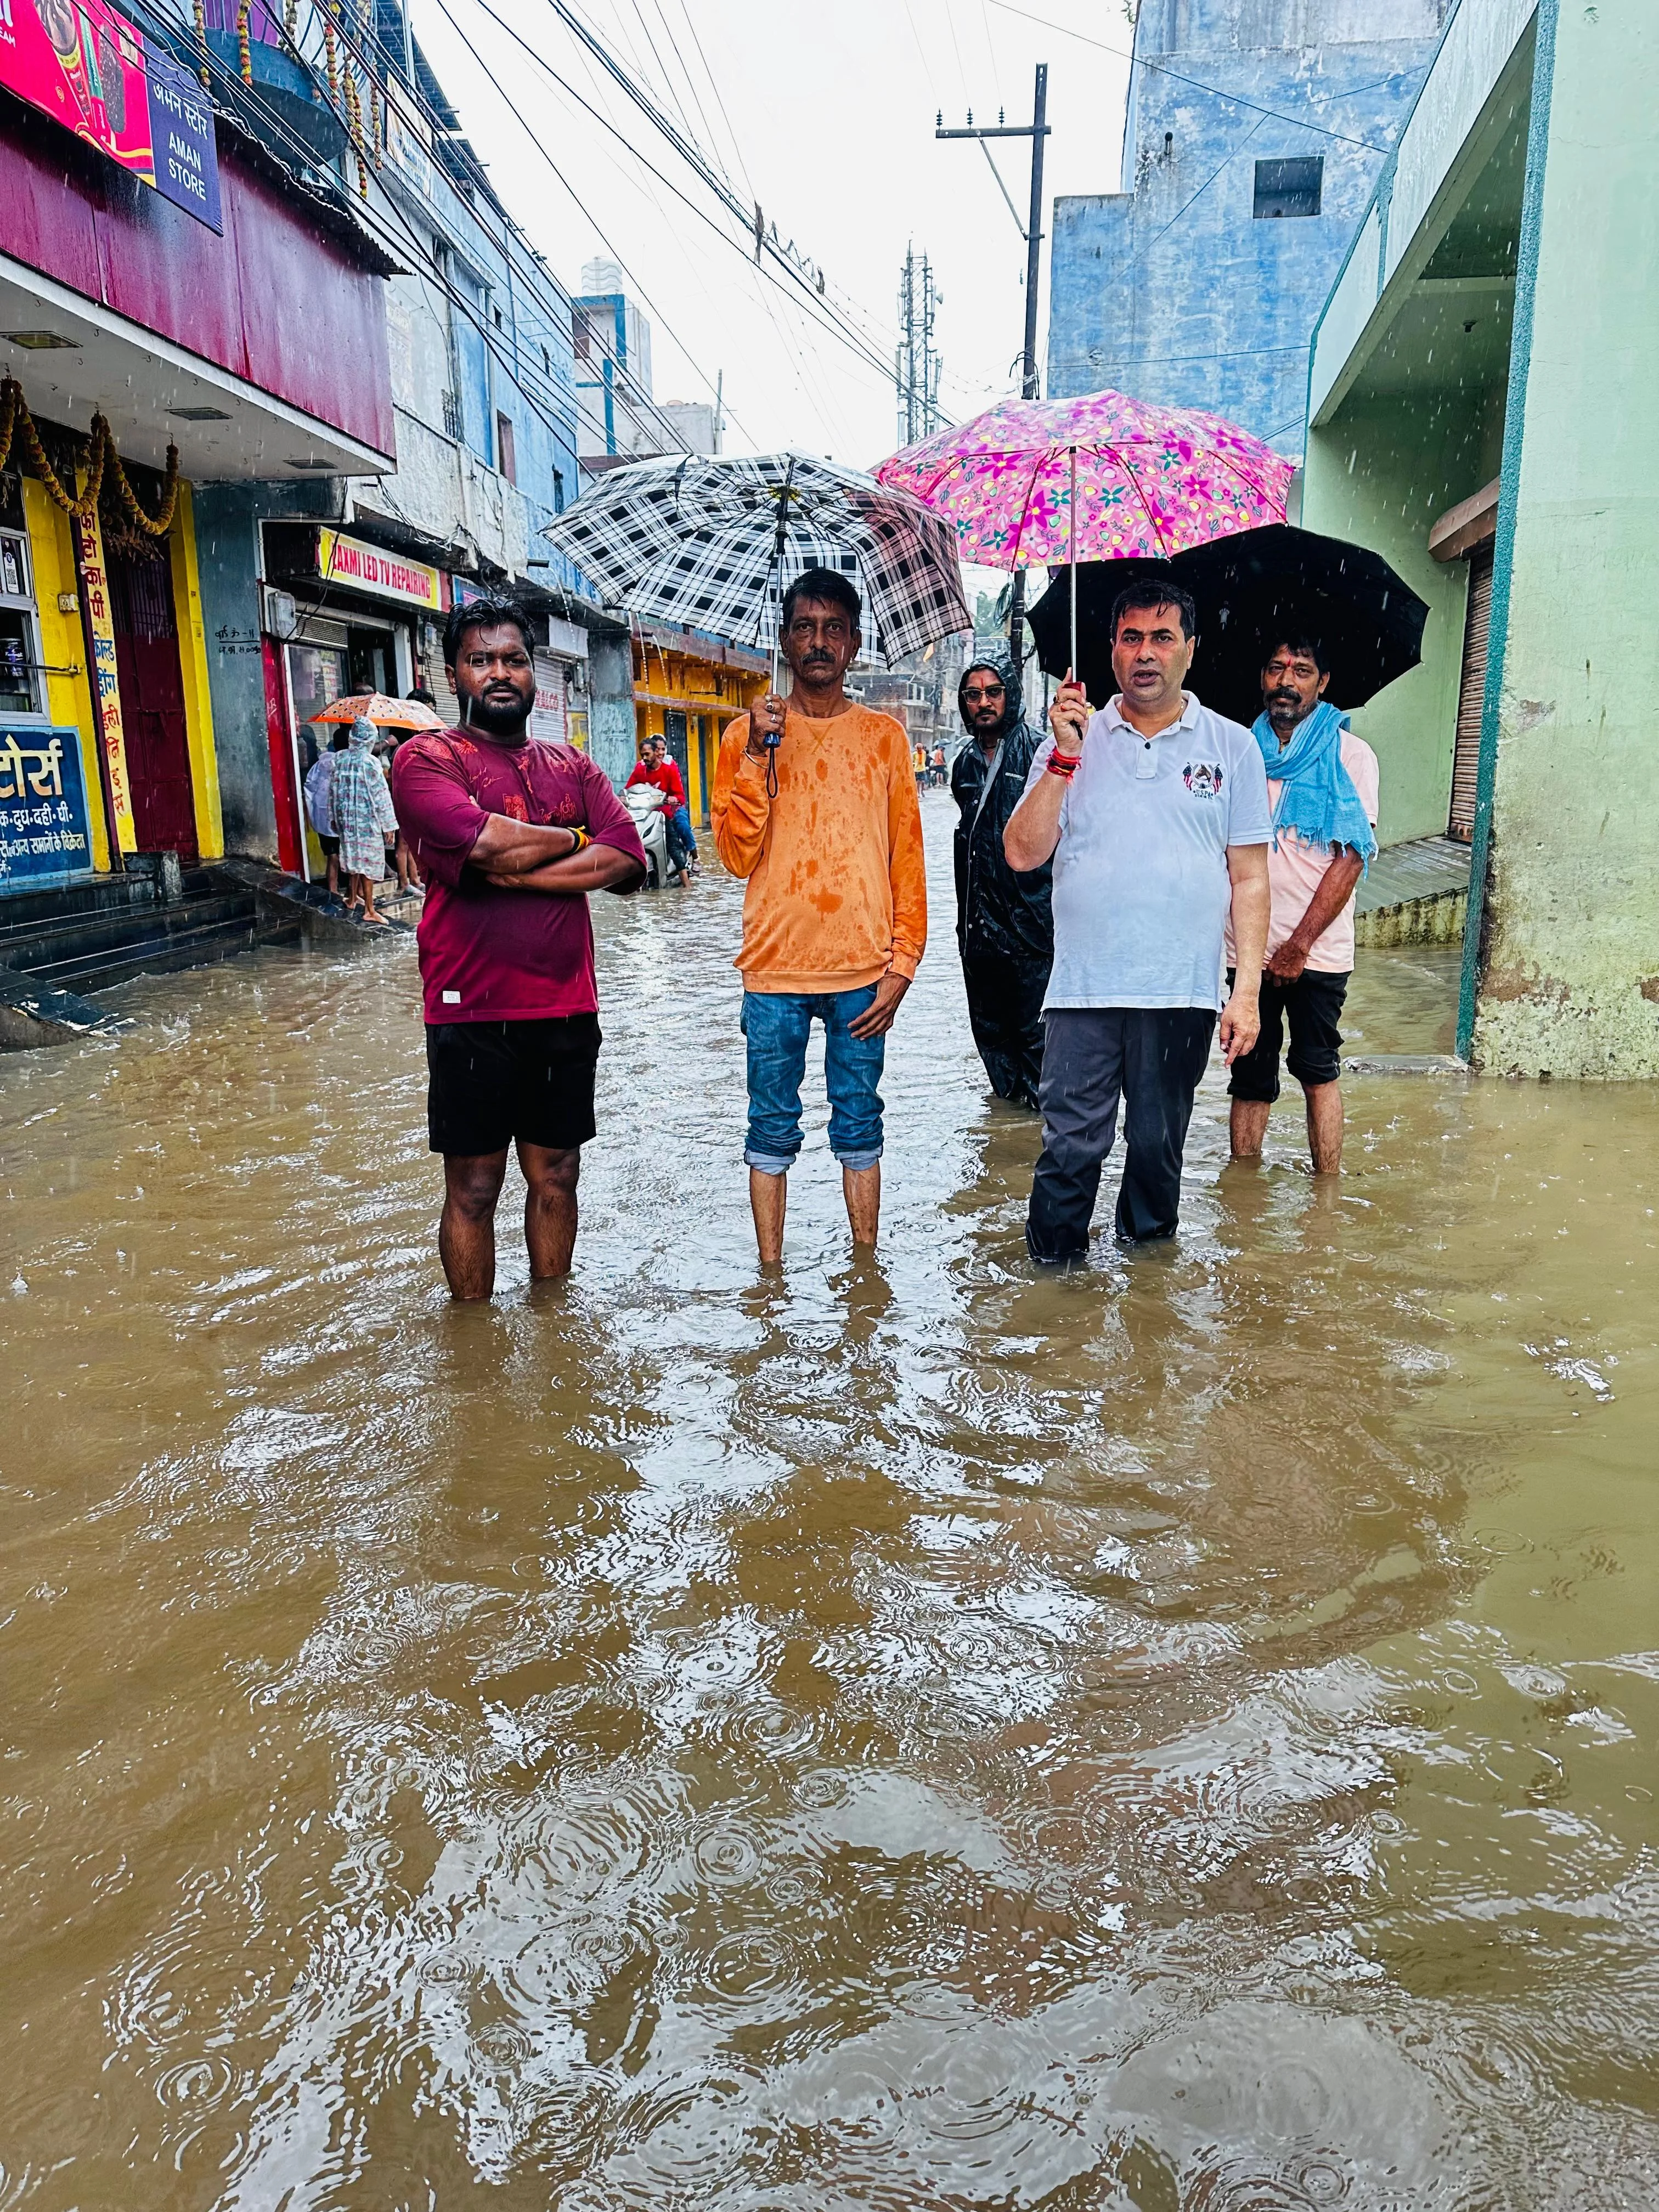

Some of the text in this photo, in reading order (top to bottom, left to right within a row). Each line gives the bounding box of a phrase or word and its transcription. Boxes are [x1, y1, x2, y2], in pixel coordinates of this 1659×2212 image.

[153, 83, 182, 119] अमन
[169, 131, 202, 172] AMAN
[168, 157, 206, 201] STORE
[331, 543, 361, 577] LAXMI
[363, 553, 378, 582] LED
[379, 558, 390, 586] TV
[392, 563, 431, 599] REPAIRING
